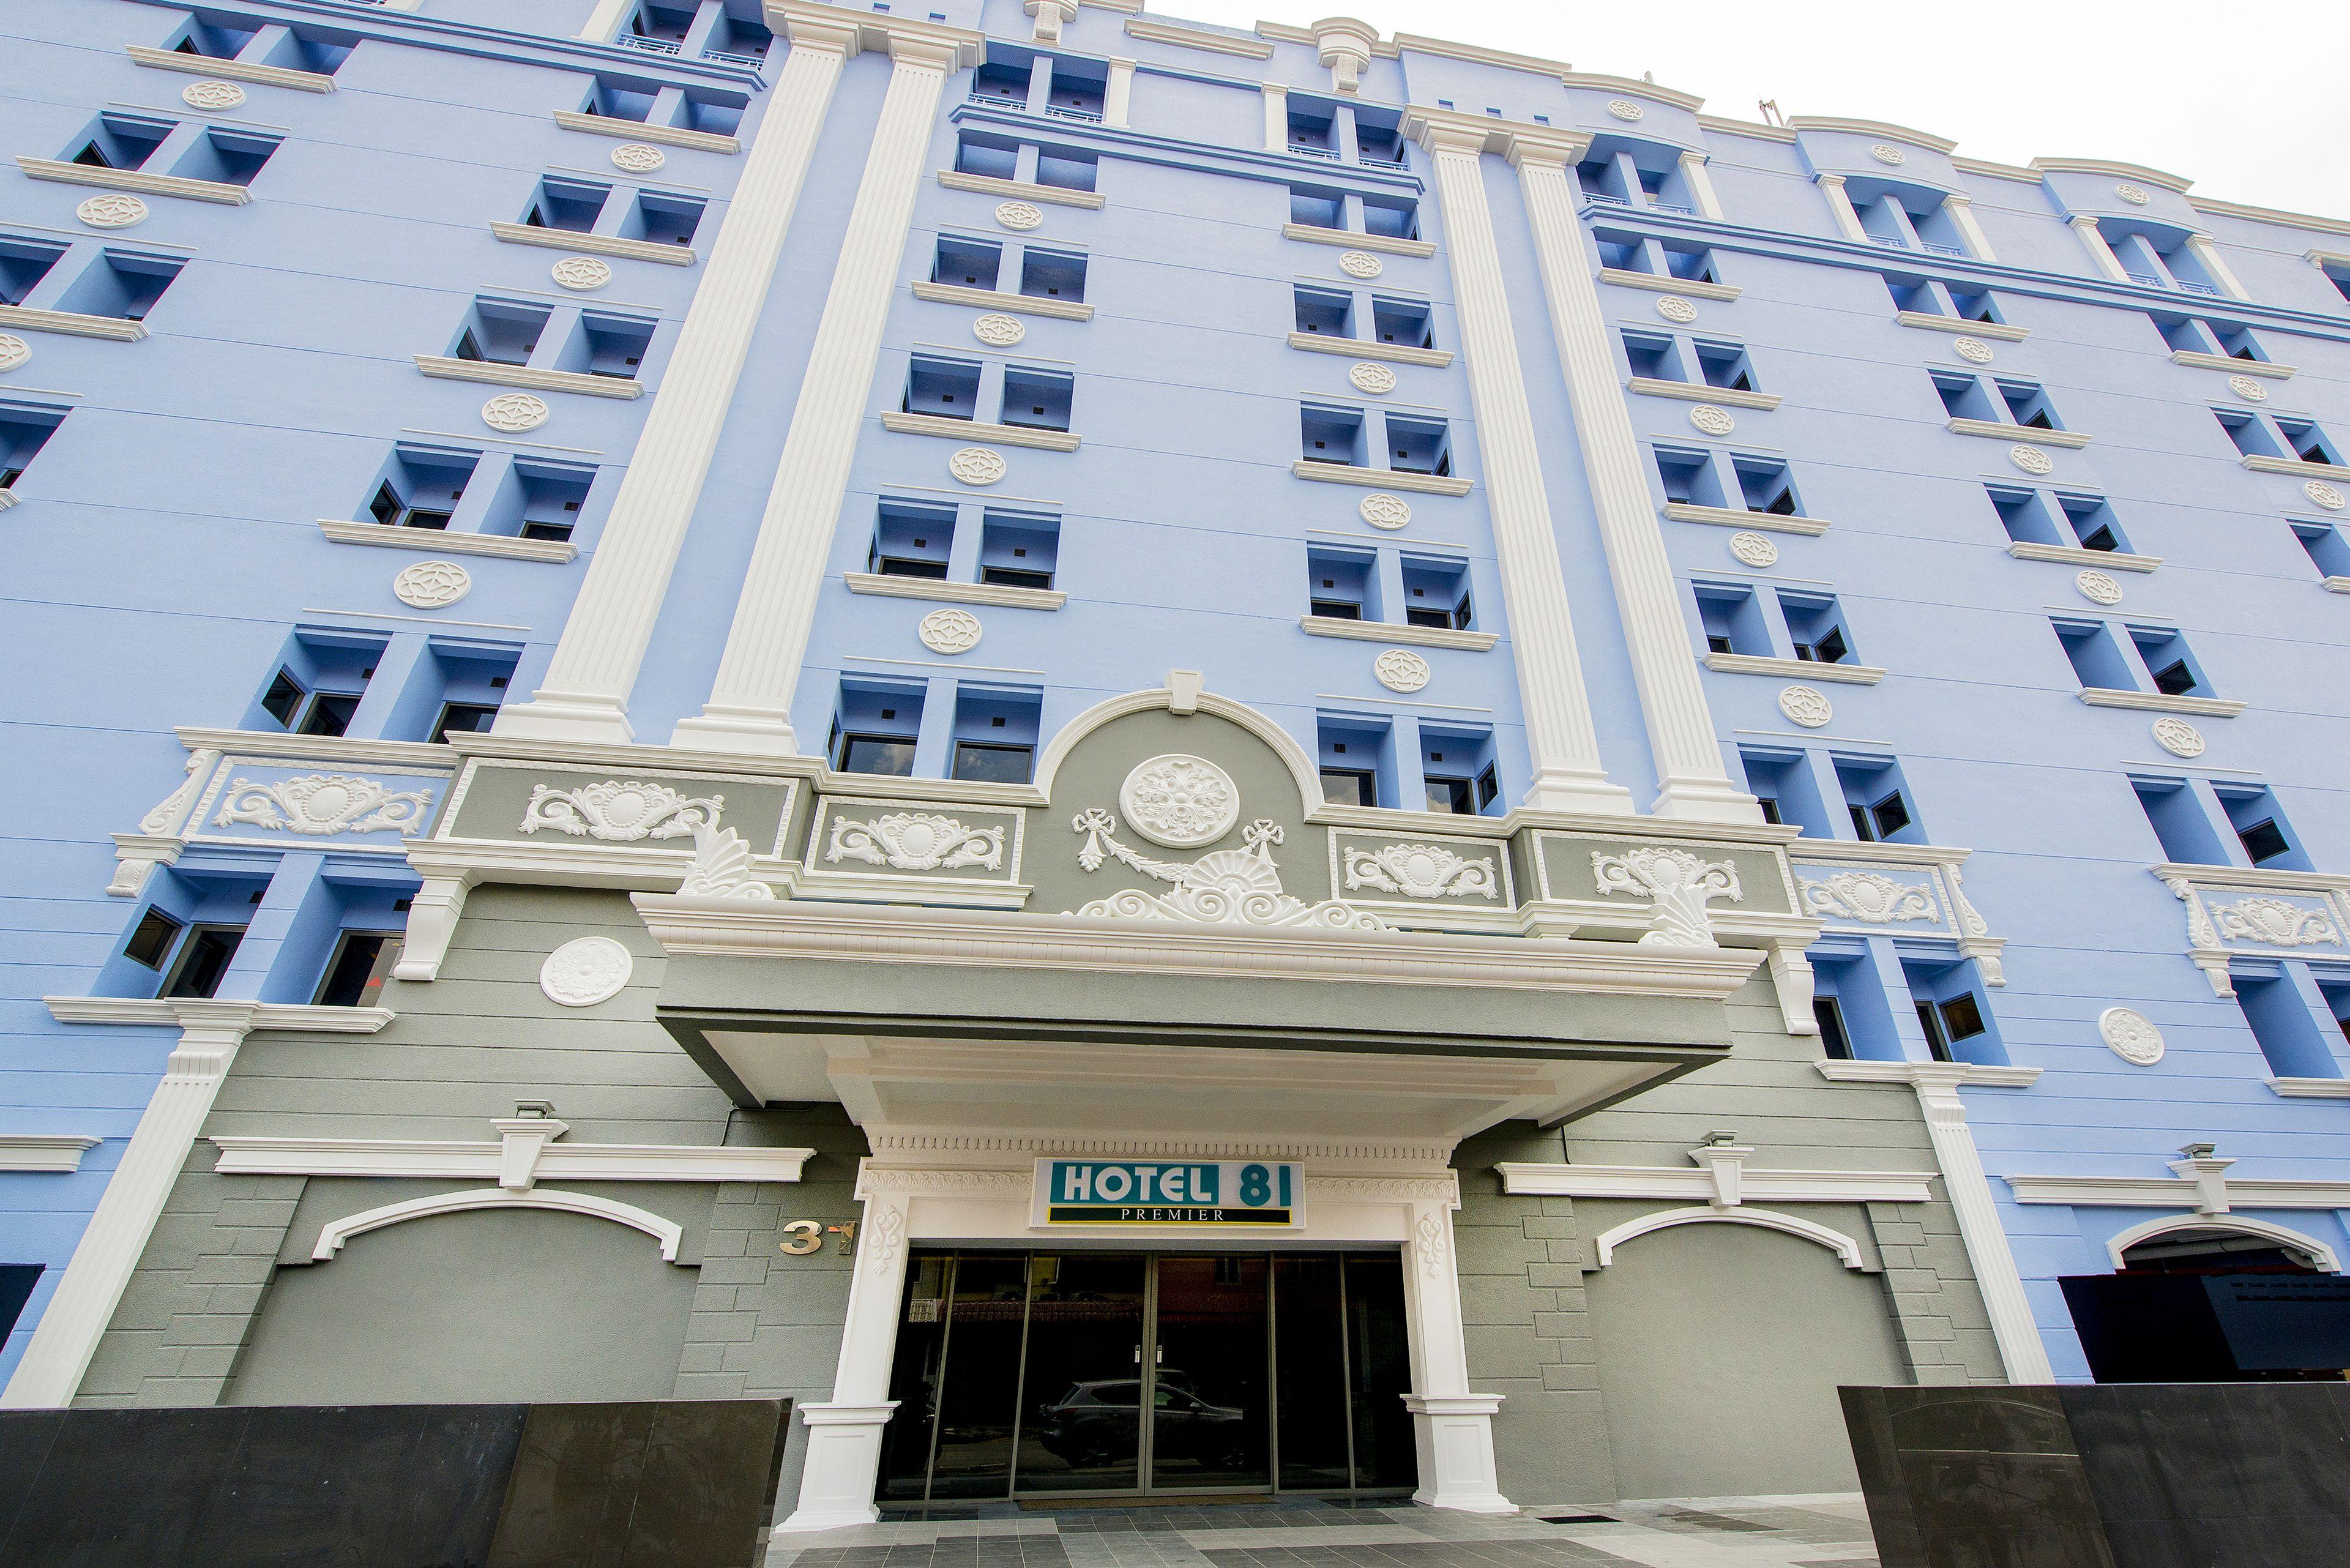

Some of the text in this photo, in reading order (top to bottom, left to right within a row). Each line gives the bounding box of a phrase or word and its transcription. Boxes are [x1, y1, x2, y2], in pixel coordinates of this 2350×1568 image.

[1064, 1164, 1292, 1207] HOTEL 81
[1121, 1208, 1224, 1221] PREMIER
[779, 1220, 856, 1255] 31
